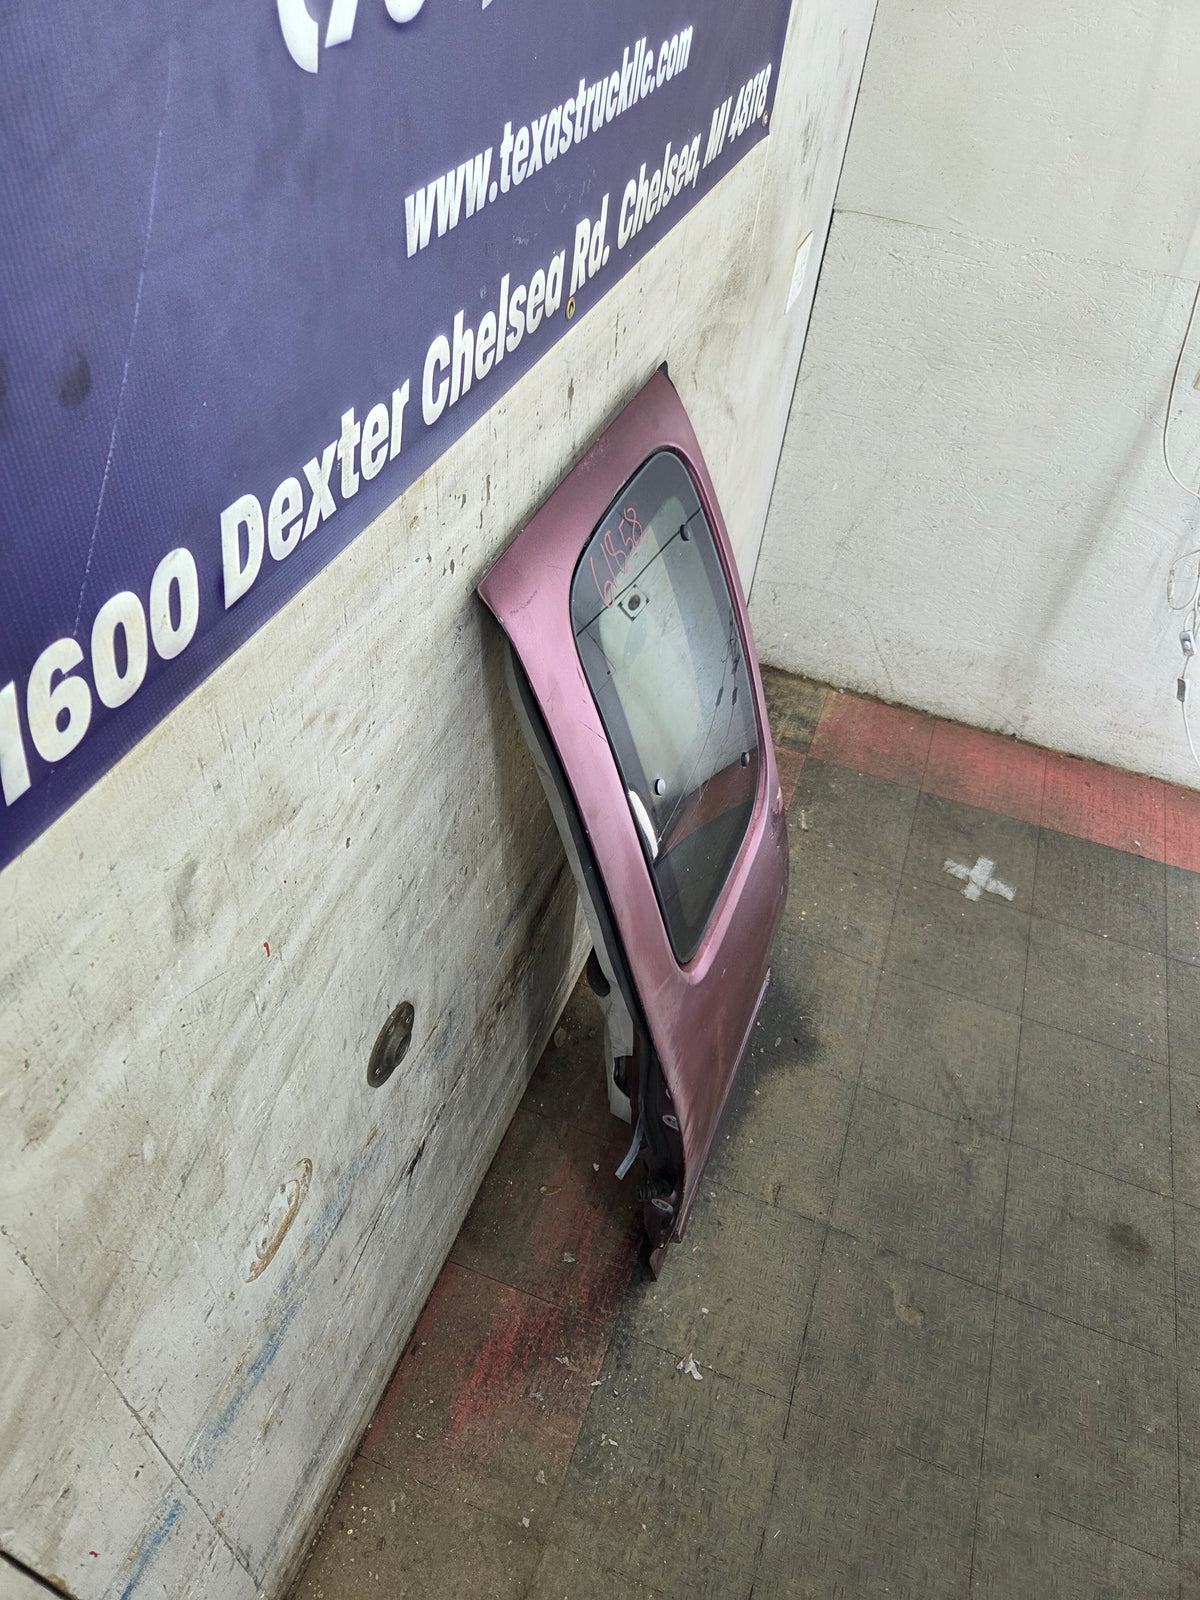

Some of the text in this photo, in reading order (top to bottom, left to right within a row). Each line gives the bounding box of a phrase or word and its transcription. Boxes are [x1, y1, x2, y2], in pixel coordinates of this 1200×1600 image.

[220, 378, 410, 610] Dexter
[422, 249, 565, 426] Chelsea
[569, 192, 611, 297] Rd.
[617, 133, 702, 250] Chelsea,
[702, 95, 733, 169] MI
[728, 63, 772, 144] 48118
[404, 25, 694, 258] www.texastruckllc.com
